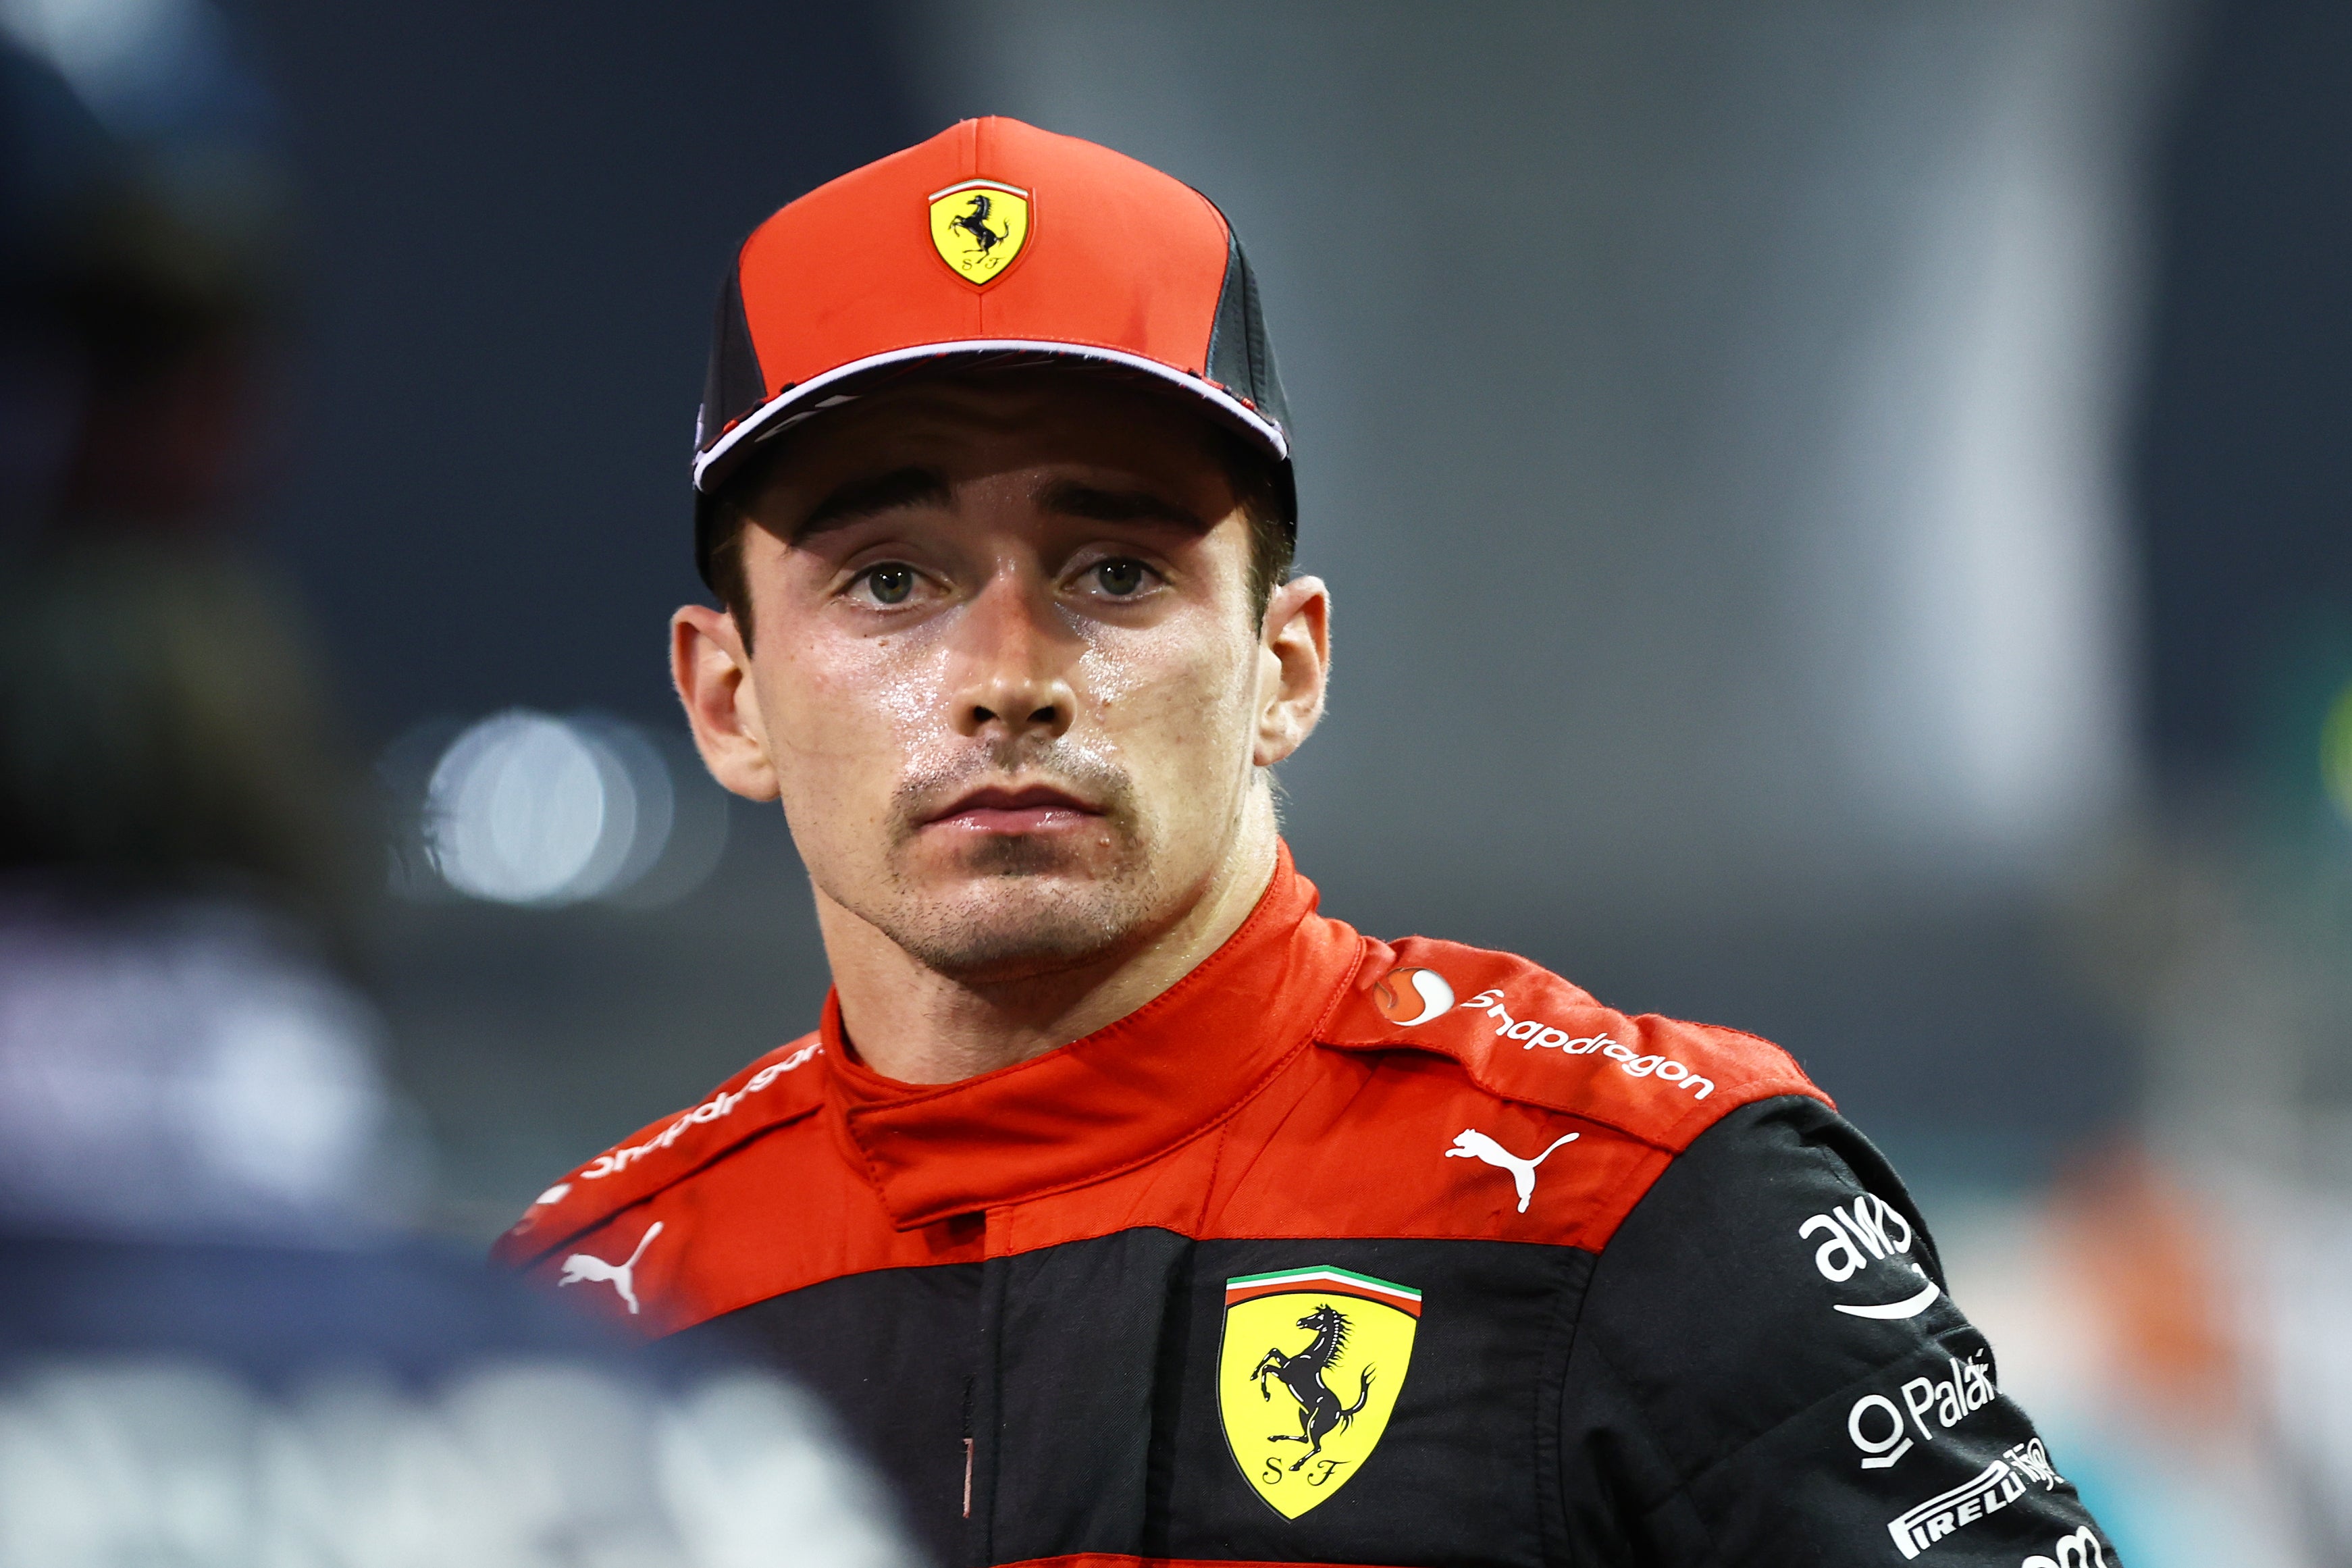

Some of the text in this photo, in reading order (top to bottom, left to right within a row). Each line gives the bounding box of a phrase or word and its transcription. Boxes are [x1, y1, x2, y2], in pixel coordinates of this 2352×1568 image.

[962, 257, 1005, 271] S F
[1460, 989, 1715, 1099] Snapdragon
[580, 1042, 825, 1179] Snapdrgon
[1262, 1457, 1351, 1486] S F
[1887, 1459, 2027, 1560] PIRELLI
